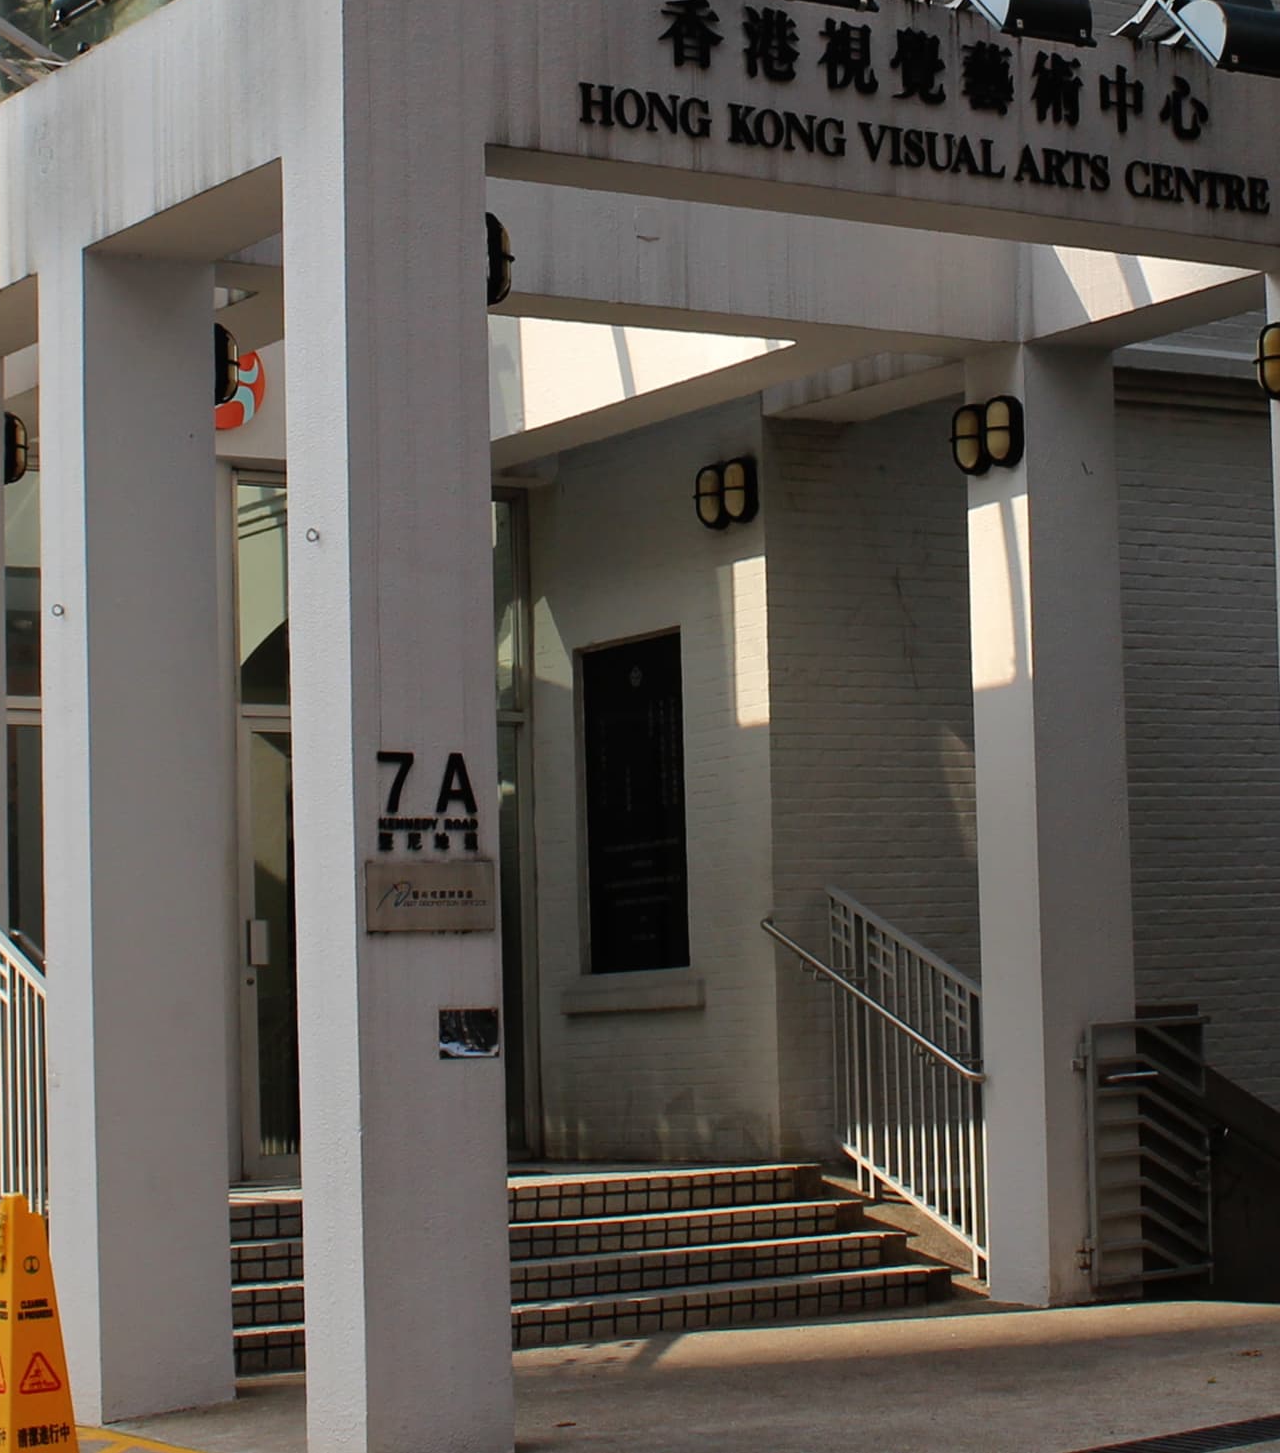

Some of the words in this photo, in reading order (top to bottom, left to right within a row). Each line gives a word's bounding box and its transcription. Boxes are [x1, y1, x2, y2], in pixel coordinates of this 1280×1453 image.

[579, 82, 713, 139] HONG
[727, 102, 847, 157] KONG
[857, 121, 1006, 179] VISUAL
[1013, 143, 1111, 192] ARTS
[1124, 160, 1271, 215] CENTRE
[444, 817, 479, 831] ROAD
